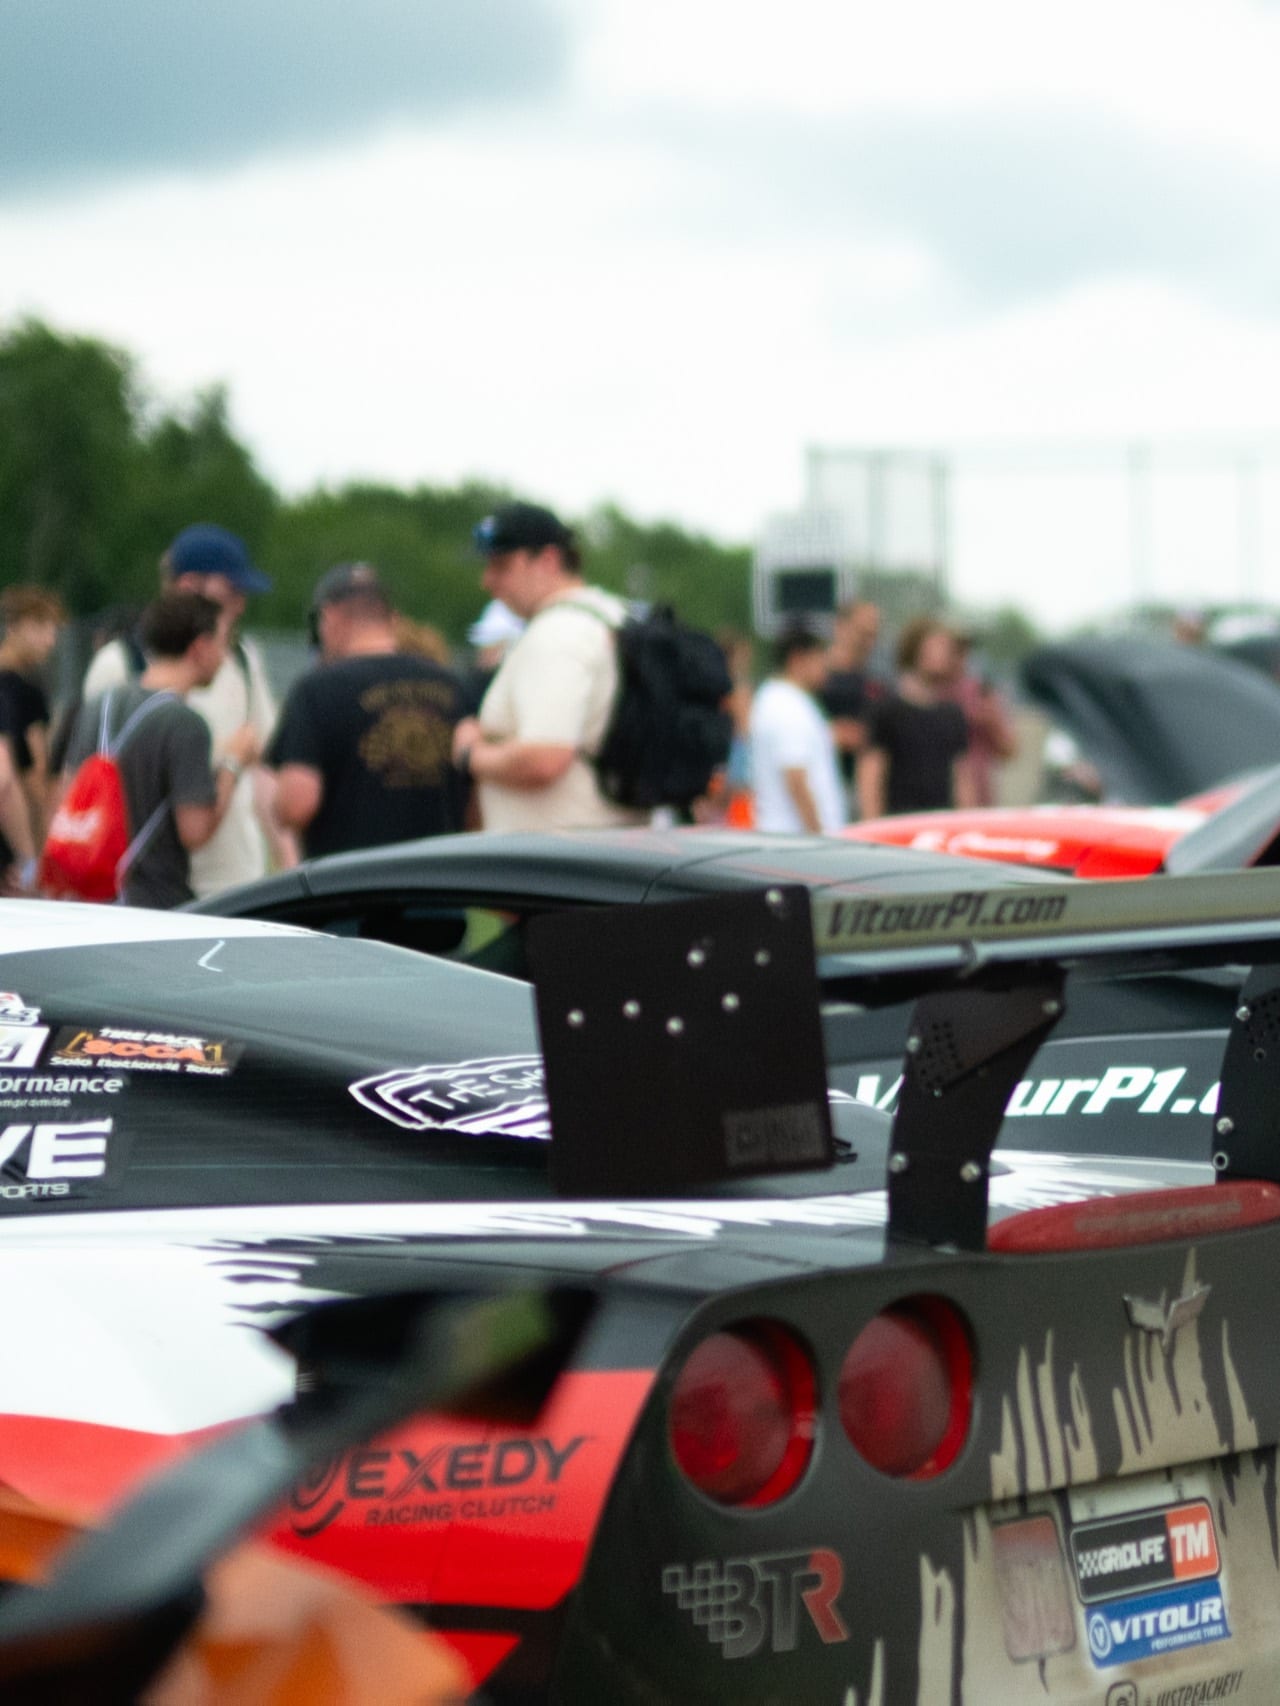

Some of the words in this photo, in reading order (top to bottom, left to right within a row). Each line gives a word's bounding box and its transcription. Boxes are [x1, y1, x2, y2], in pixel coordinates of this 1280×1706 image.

[827, 891, 1068, 938] VitourP1.com
[346, 1436, 586, 1499] EXEDY
[365, 1503, 453, 1526] RACING
[459, 1496, 556, 1519] CLUTCH
[1169, 1521, 1210, 1563] TM
[1110, 1597, 1222, 1645] VITOUR
